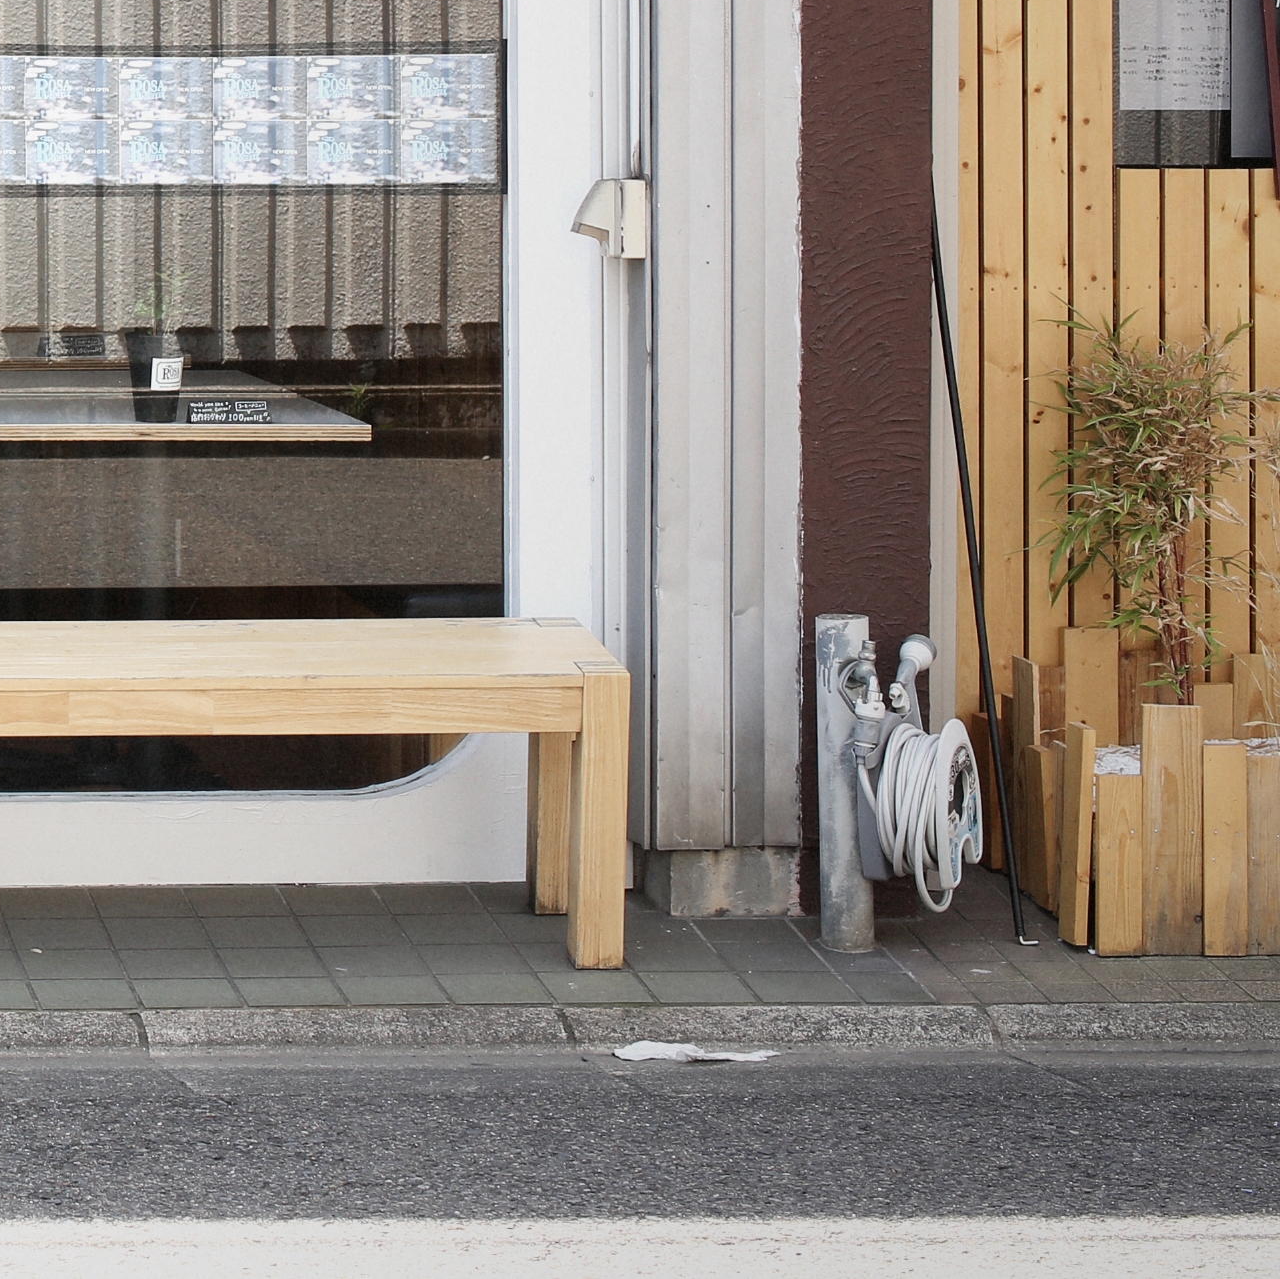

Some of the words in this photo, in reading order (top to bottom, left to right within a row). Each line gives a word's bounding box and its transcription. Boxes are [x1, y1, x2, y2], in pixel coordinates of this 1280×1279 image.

[34, 79, 71, 100] ROSA
[128, 79, 165, 100] ROSA
[221, 78, 258, 99] ROSA
[316, 77, 353, 98] ROSA
[409, 76, 446, 97] ROSA
[34, 141, 72, 162] ROSA
[128, 141, 166, 162] ROSA
[222, 141, 259, 162] ROSA
[316, 141, 353, 162] ROSA
[410, 140, 447, 161] ROSA
